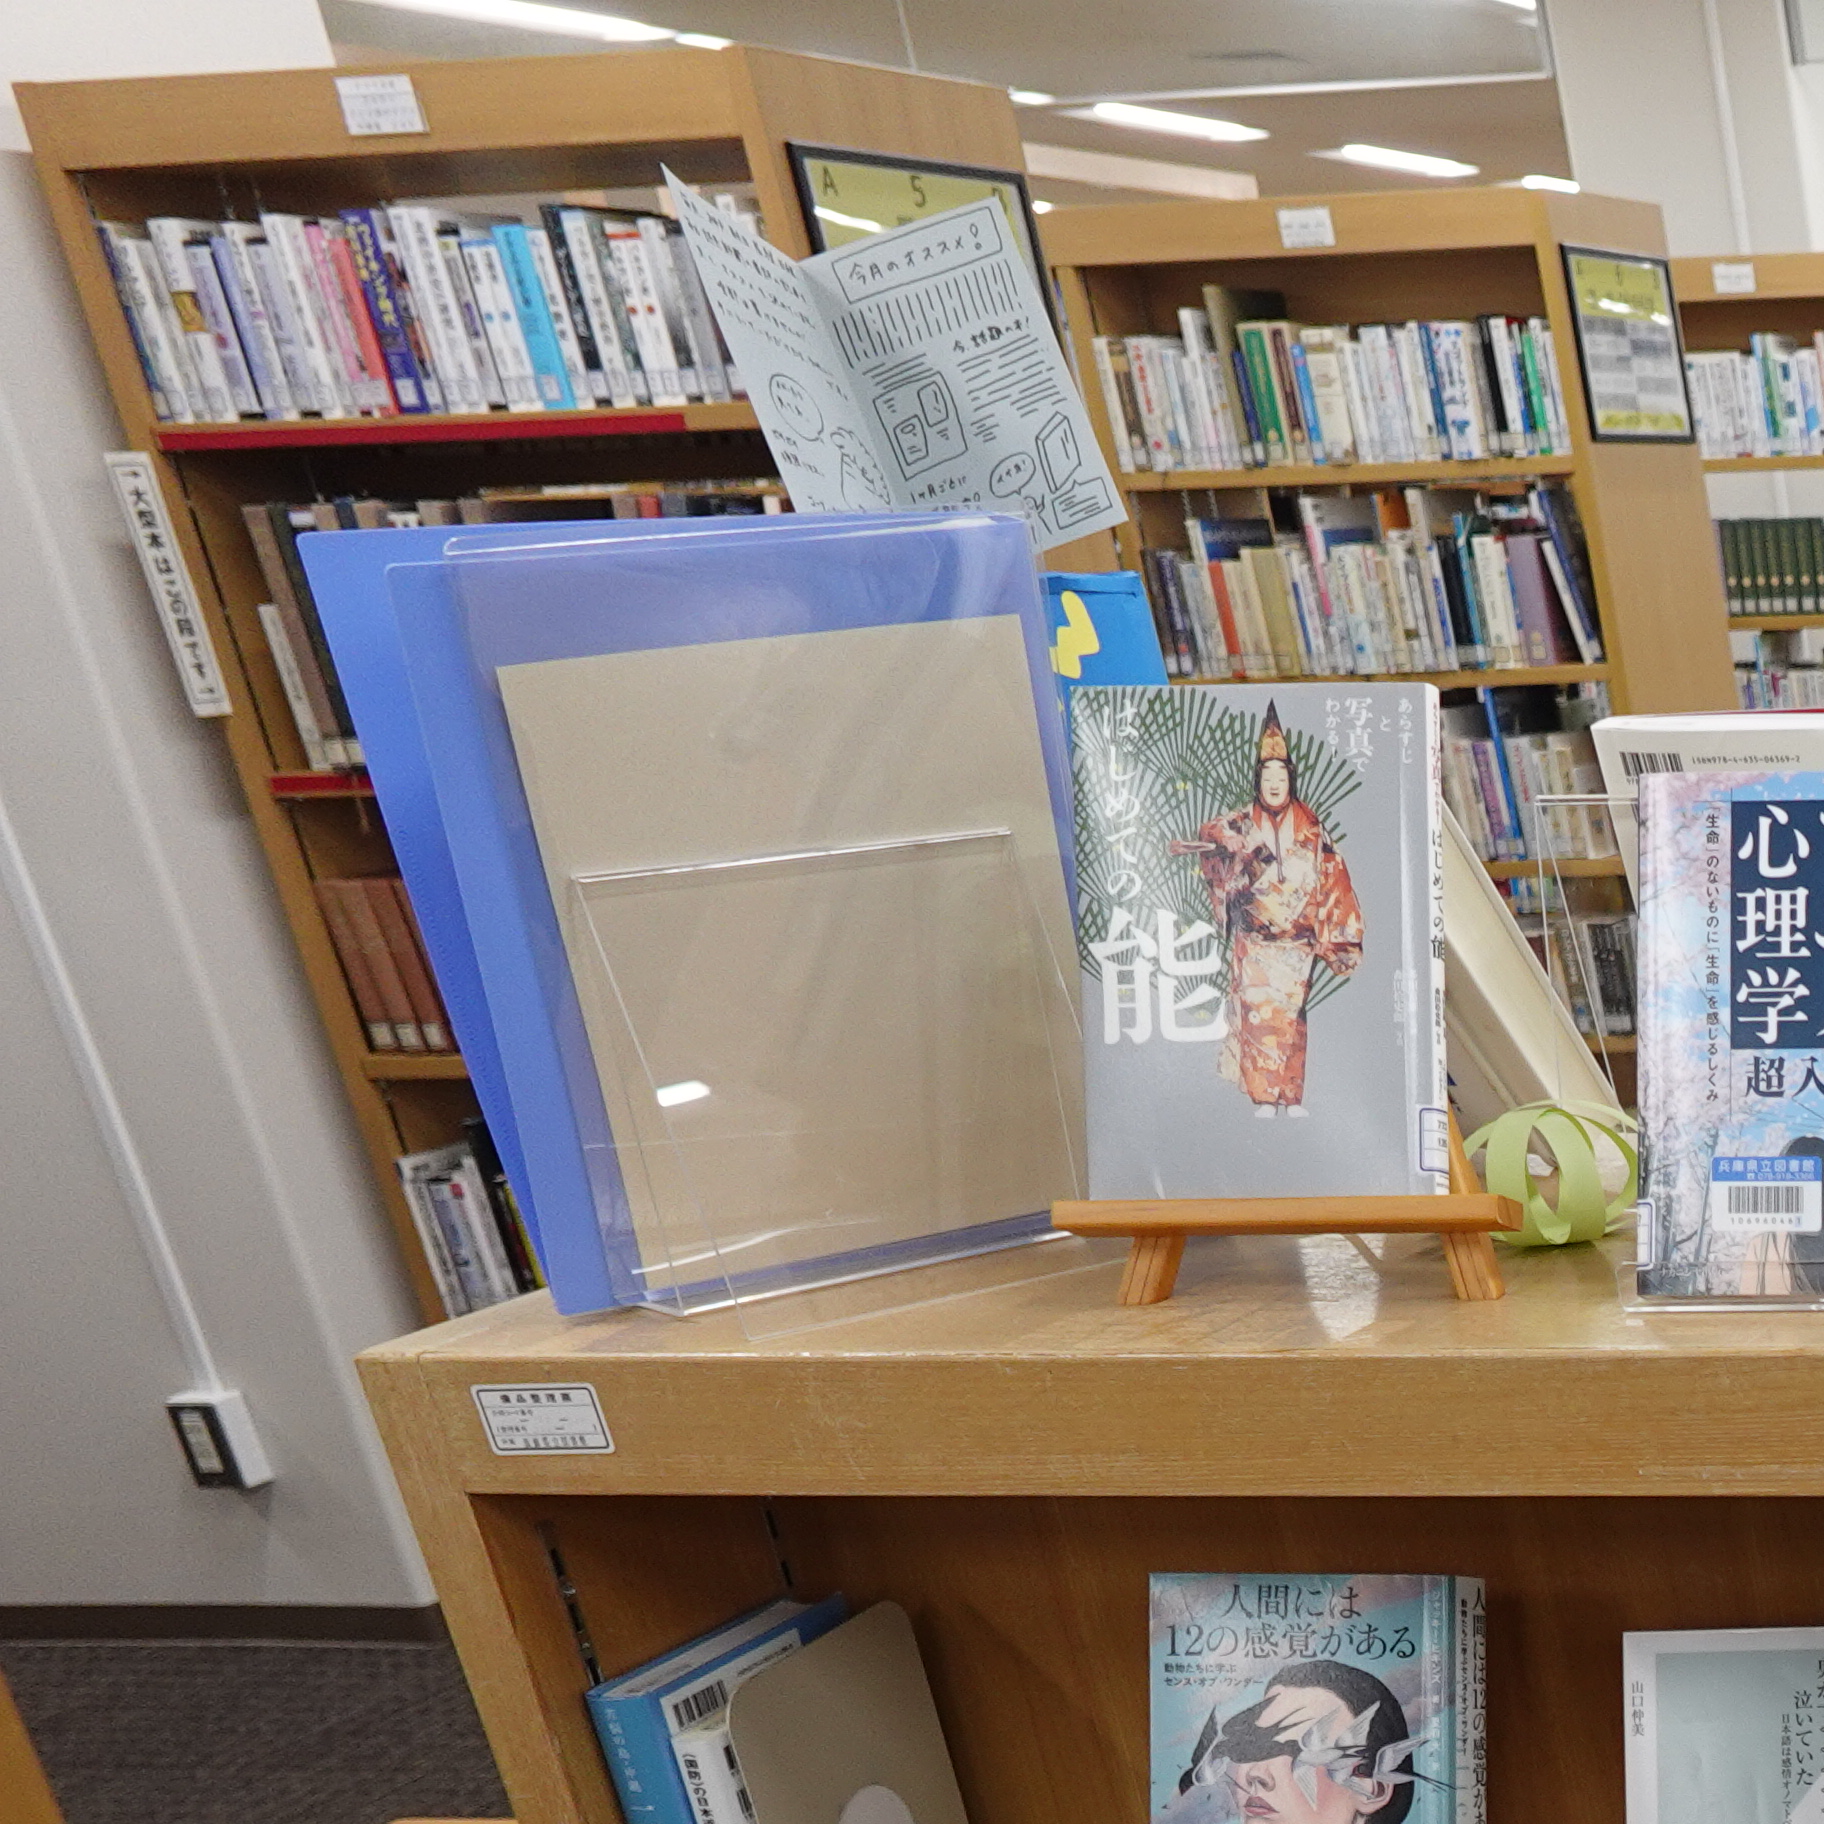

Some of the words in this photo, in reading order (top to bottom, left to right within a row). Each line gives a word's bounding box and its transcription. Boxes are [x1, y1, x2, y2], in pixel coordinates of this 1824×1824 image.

[821, 169, 839, 199] A
[1344, 697, 1374, 773] 写真で
[1397, 698, 1414, 765] あらすじ
[1102, 698, 1143, 901] はじめての
[1704, 803, 1721, 1104] 「生命」のないものに「生命」を感じるしくみ
[1736, 803, 1813, 1045] 心理学
[1087, 905, 1229, 1045] 能
[1717, 1159, 1816, 1173] 兵庫県立図書館
[1220, 1583, 1363, 1621] 人間には
[1163, 1622, 1418, 1661] 12の感覚がある
[1163, 1662, 1237, 1674] 動物たちに学ぶ
[1163, 1676, 1265, 1688] センス・オブ・ワンダー
[1630, 1680, 1645, 1737] 山口仲美
[1793, 1689, 1814, 1787] 泣いていた
